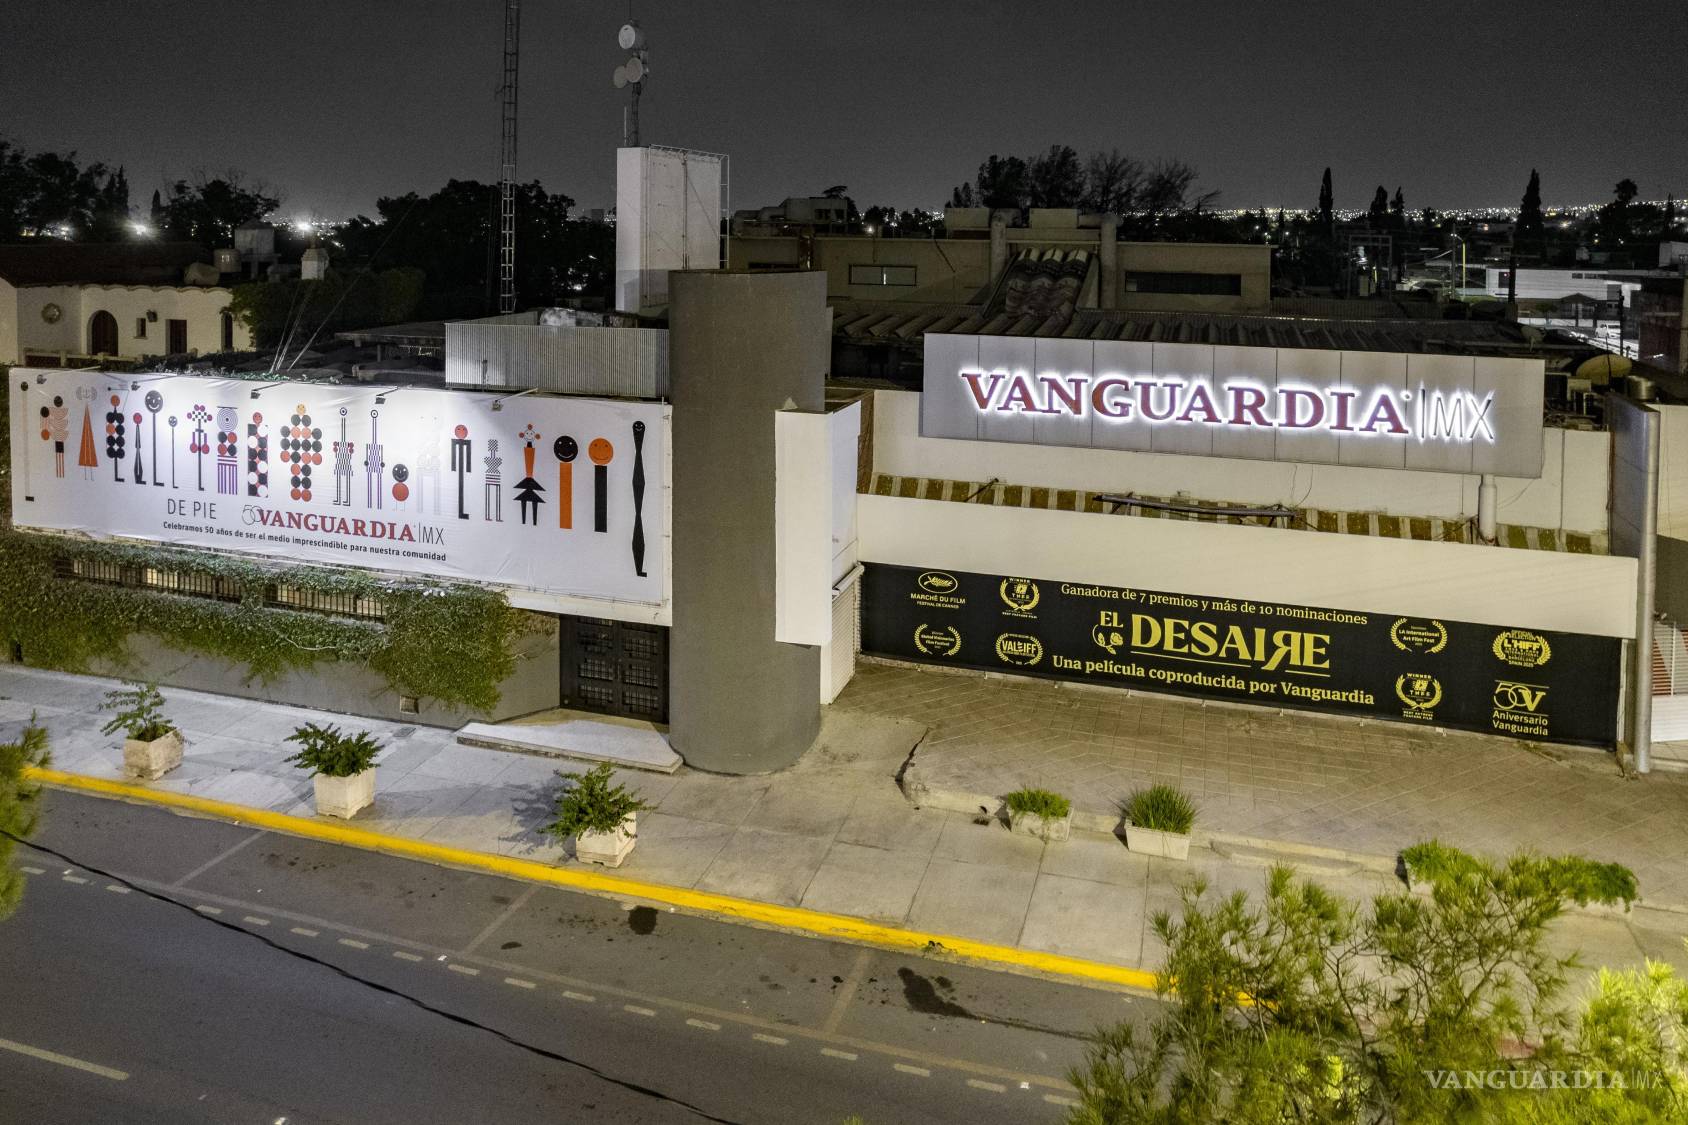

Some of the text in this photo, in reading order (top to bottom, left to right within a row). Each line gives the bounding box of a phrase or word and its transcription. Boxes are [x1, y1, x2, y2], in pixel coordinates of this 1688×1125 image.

[962, 373, 1409, 434] VANGUARDIA
[167, 498, 217, 519] DE PIE
[256, 508, 416, 542] VANGUARDIA
[163, 521, 203, 533] Celebramos
[205, 526, 214, 534] 50
[216, 527, 233, 536] años
[234, 530, 244, 538] de
[258, 532, 266, 540] el
[268, 534, 290, 543] medio
[292, 536, 348, 550] imprescindible
[350, 544, 367, 552] para
[369, 546, 400, 556] nuestra
[402, 549, 446, 561] comunidad
[910, 593, 938, 601] MARCHÉ
[1061, 583, 1368, 625] Ganadora de 7 premios y más de 10 nominaciones
[1100, 610, 1124, 628] EL
[1053, 655, 1375, 705] Una película coproducida por Vanguardia
[1493, 711, 1548, 725] Aniversario
[1493, 720, 1548, 736] Vanguardia
